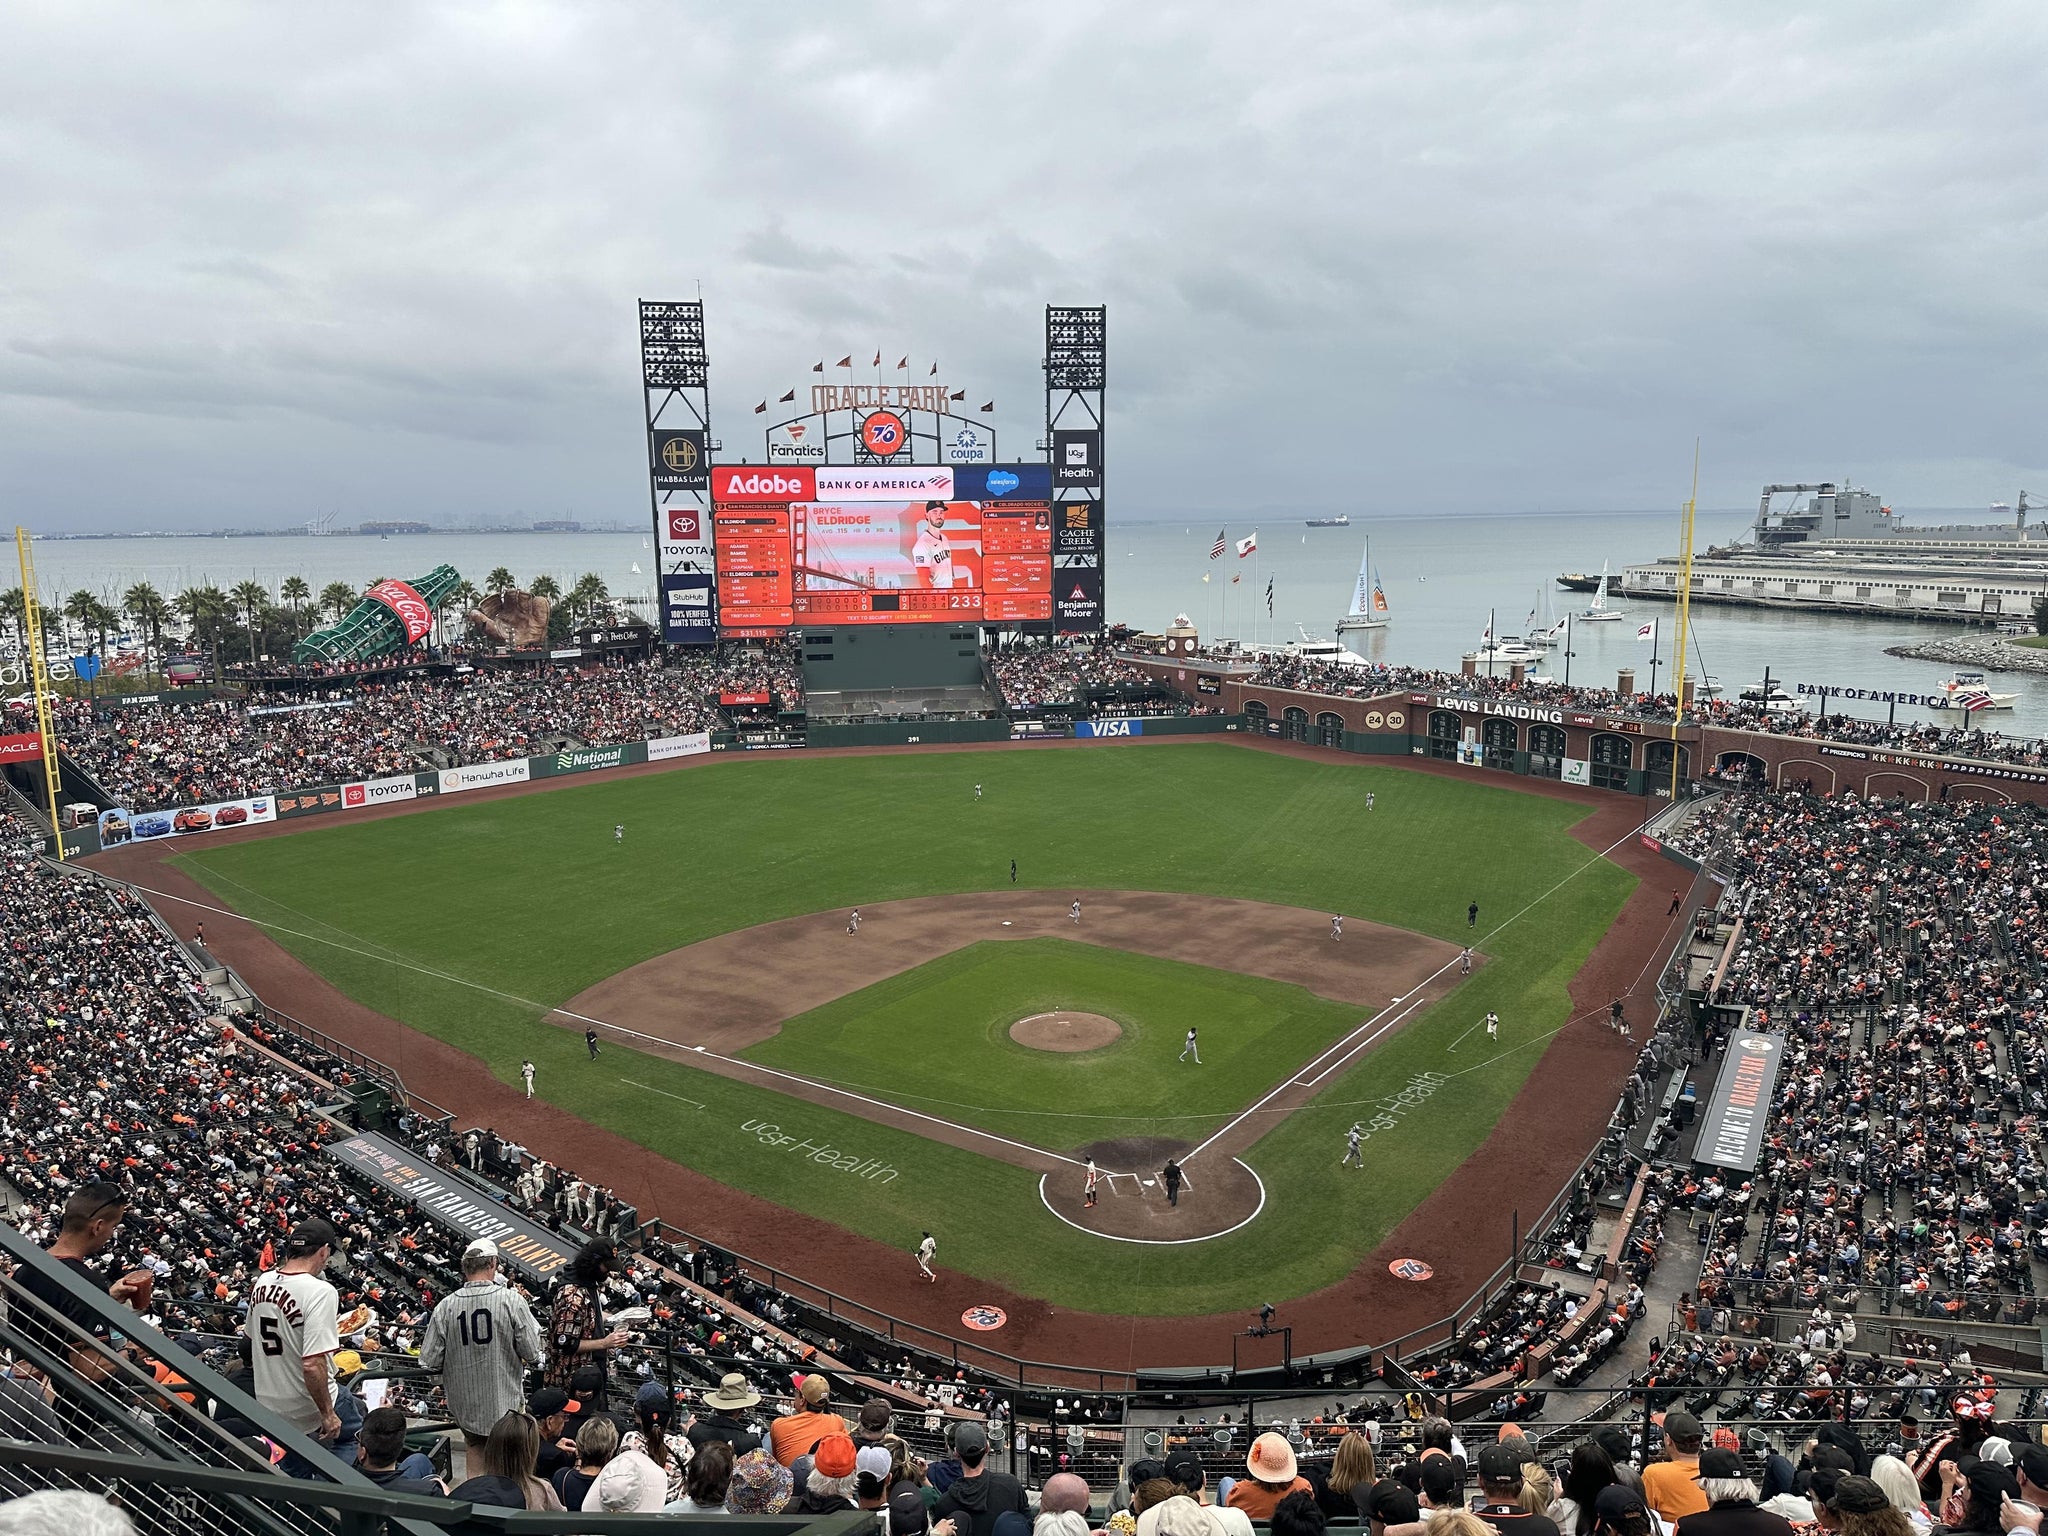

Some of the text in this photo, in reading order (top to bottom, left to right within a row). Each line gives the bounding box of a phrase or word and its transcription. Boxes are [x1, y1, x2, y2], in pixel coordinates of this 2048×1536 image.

[812, 386, 950, 414] ORACLE PARK
[871, 425, 896, 443] 76
[771, 444, 824, 458] Fanatics
[950, 448, 984, 462] coupa
[1068, 449, 1085, 458] UCSF
[1060, 468, 1094, 478] Health
[727, 474, 802, 494] Adobe
[819, 480, 926, 489] BANK OF AMERICA
[817, 516, 871, 525] ELDRIDGE
[664, 546, 708, 555] TOYOTA
[1058, 601, 1097, 610] Benjamin
[669, 618, 711, 627] GIANTS TICKETS
[624, 632, 638, 641] Coffee
[1798, 684, 1949, 708] BANK OF AMERICA
[1390, 716, 1401, 724] 30
[1484, 702, 1563, 724] LANDING
[1088, 721, 1130, 737] VISA
[573, 748, 622, 766] National
[1829, 749, 1866, 759] PRIZEPICKS
[462, 766, 525, 783] Hanwha Life
[369, 783, 412, 797] TOYOTA
[418, 786, 433, 794] 354
[1656, 789, 1671, 798] 309
[64, 846, 80, 857] 339
[1738, 1055, 1767, 1076] PARK
[1376, 1072, 1451, 1116] Health
[1728, 1075, 1761, 1107] ORACLE
[1724, 1106, 1754, 1119] TO
[1712, 1118, 1751, 1164] WELCOME
[344, 1139, 402, 1170] ORACLE PARK
[740, 1119, 898, 1184] UCSF Health
[401, 1177, 568, 1272] SAN FRANCISCO GIANTS
[456, 1308, 493, 1346] 10
[260, 1316, 283, 1356] 5
[165, 1495, 198, 1519] 317
